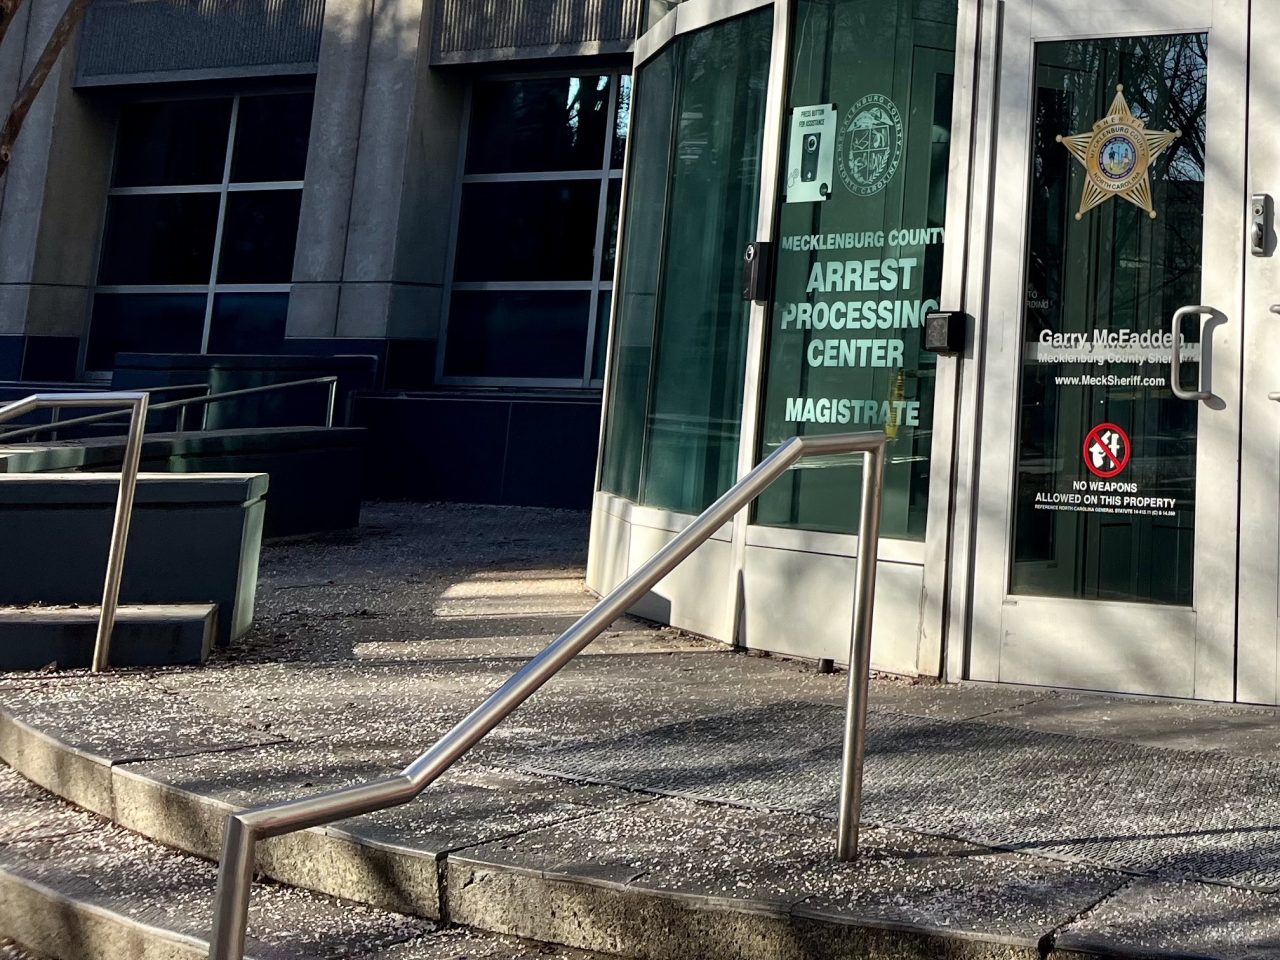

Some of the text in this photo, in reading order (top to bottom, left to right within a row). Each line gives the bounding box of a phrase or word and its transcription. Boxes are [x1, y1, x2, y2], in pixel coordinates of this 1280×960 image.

[887, 102, 903, 146] COUNTY
[1096, 116, 1143, 130] SHERIFF
[1090, 126, 1129, 159] MECKLENBURG
[1130, 131, 1146, 158] COUNTY
[860, 160, 899, 195] CAROLINA
[1093, 172, 1141, 190] NORTH CAROLINA
[781, 227, 945, 252] MECKLENBURG COUNTY
[805, 257, 918, 292] ARREST
[1038, 328, 1088, 350] Garry
[806, 338, 905, 368] CENTER
[1038, 352, 1106, 365] Mecklenburg
[1107, 353, 1145, 365] County
[1055, 375, 1166, 387] www.MeckSheriff.com
[784, 397, 921, 427] MAGISTRATE
[1072, 480, 1138, 493] NO WEAPONS
[1035, 492, 1176, 508] ALLOWED ON THIS PROPERTY
